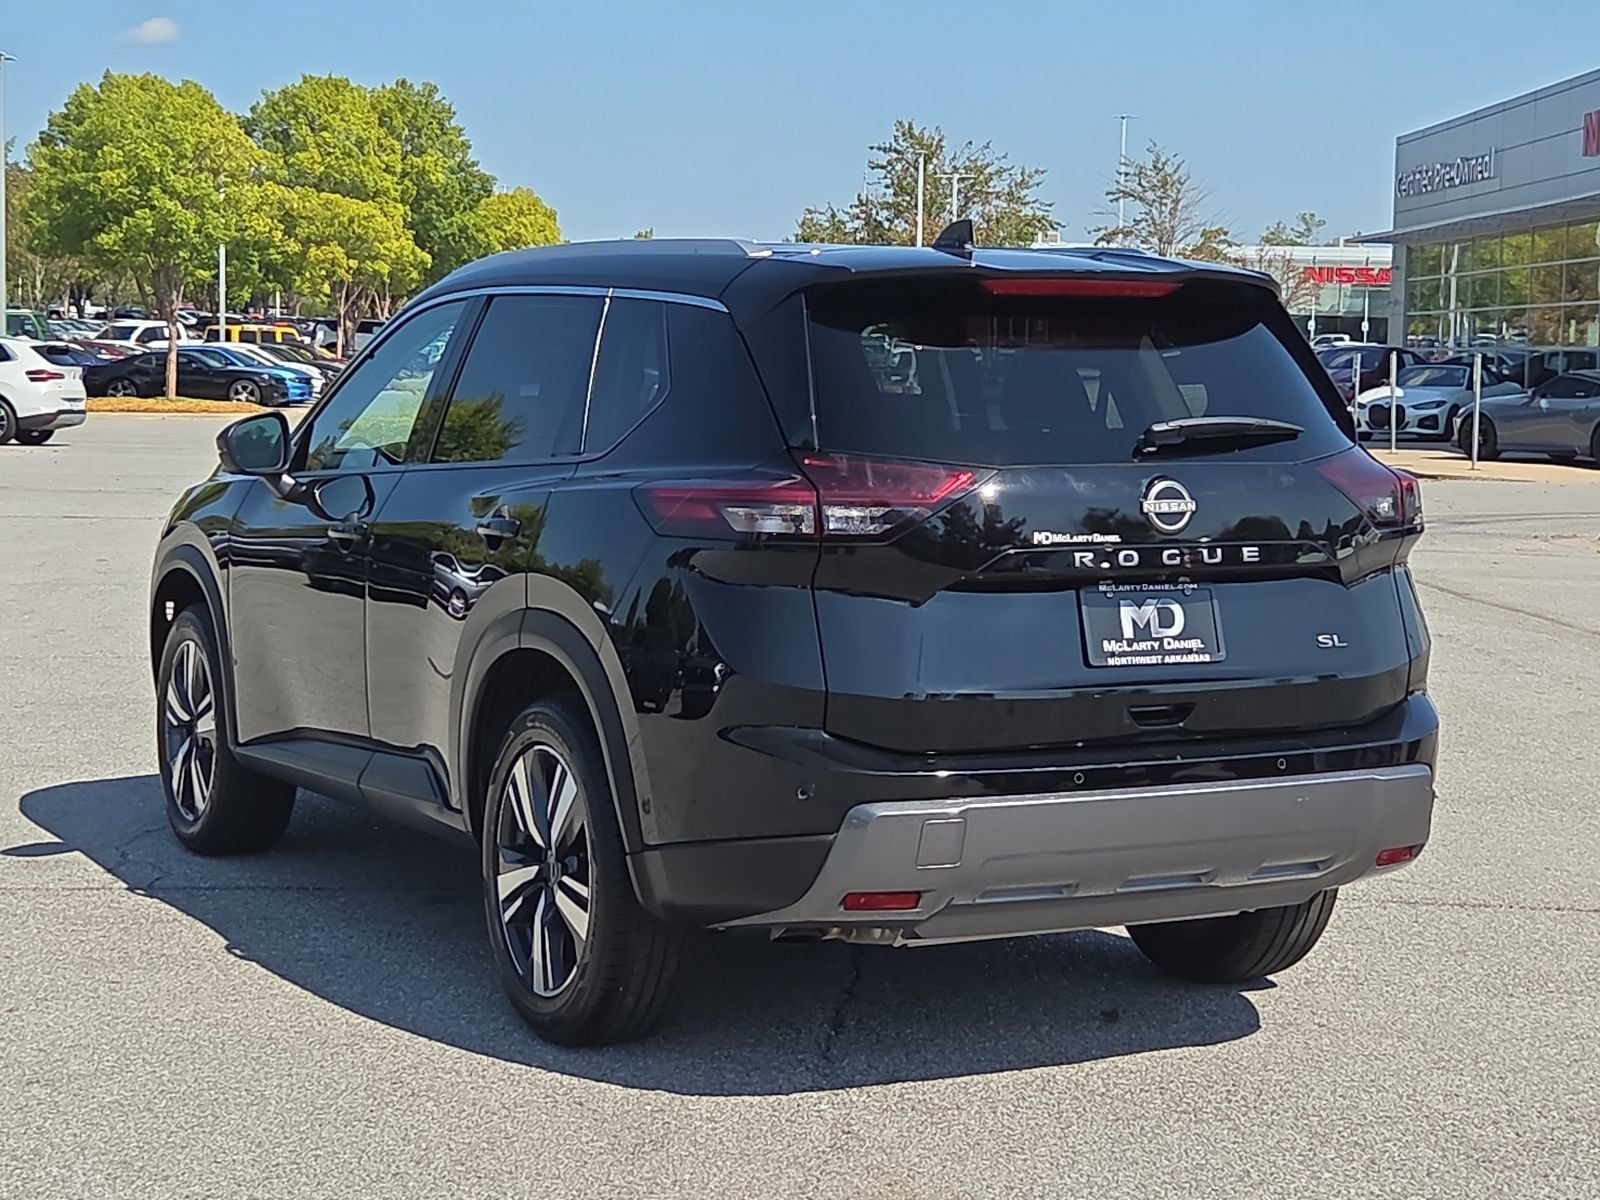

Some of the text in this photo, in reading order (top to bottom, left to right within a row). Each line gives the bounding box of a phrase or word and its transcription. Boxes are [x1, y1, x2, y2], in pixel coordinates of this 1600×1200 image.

[1143, 500, 1197, 513] NISSAN
[1316, 634, 1348, 648] SL
[1107, 653, 1211, 665] NORTHWEST ARKANSAS
